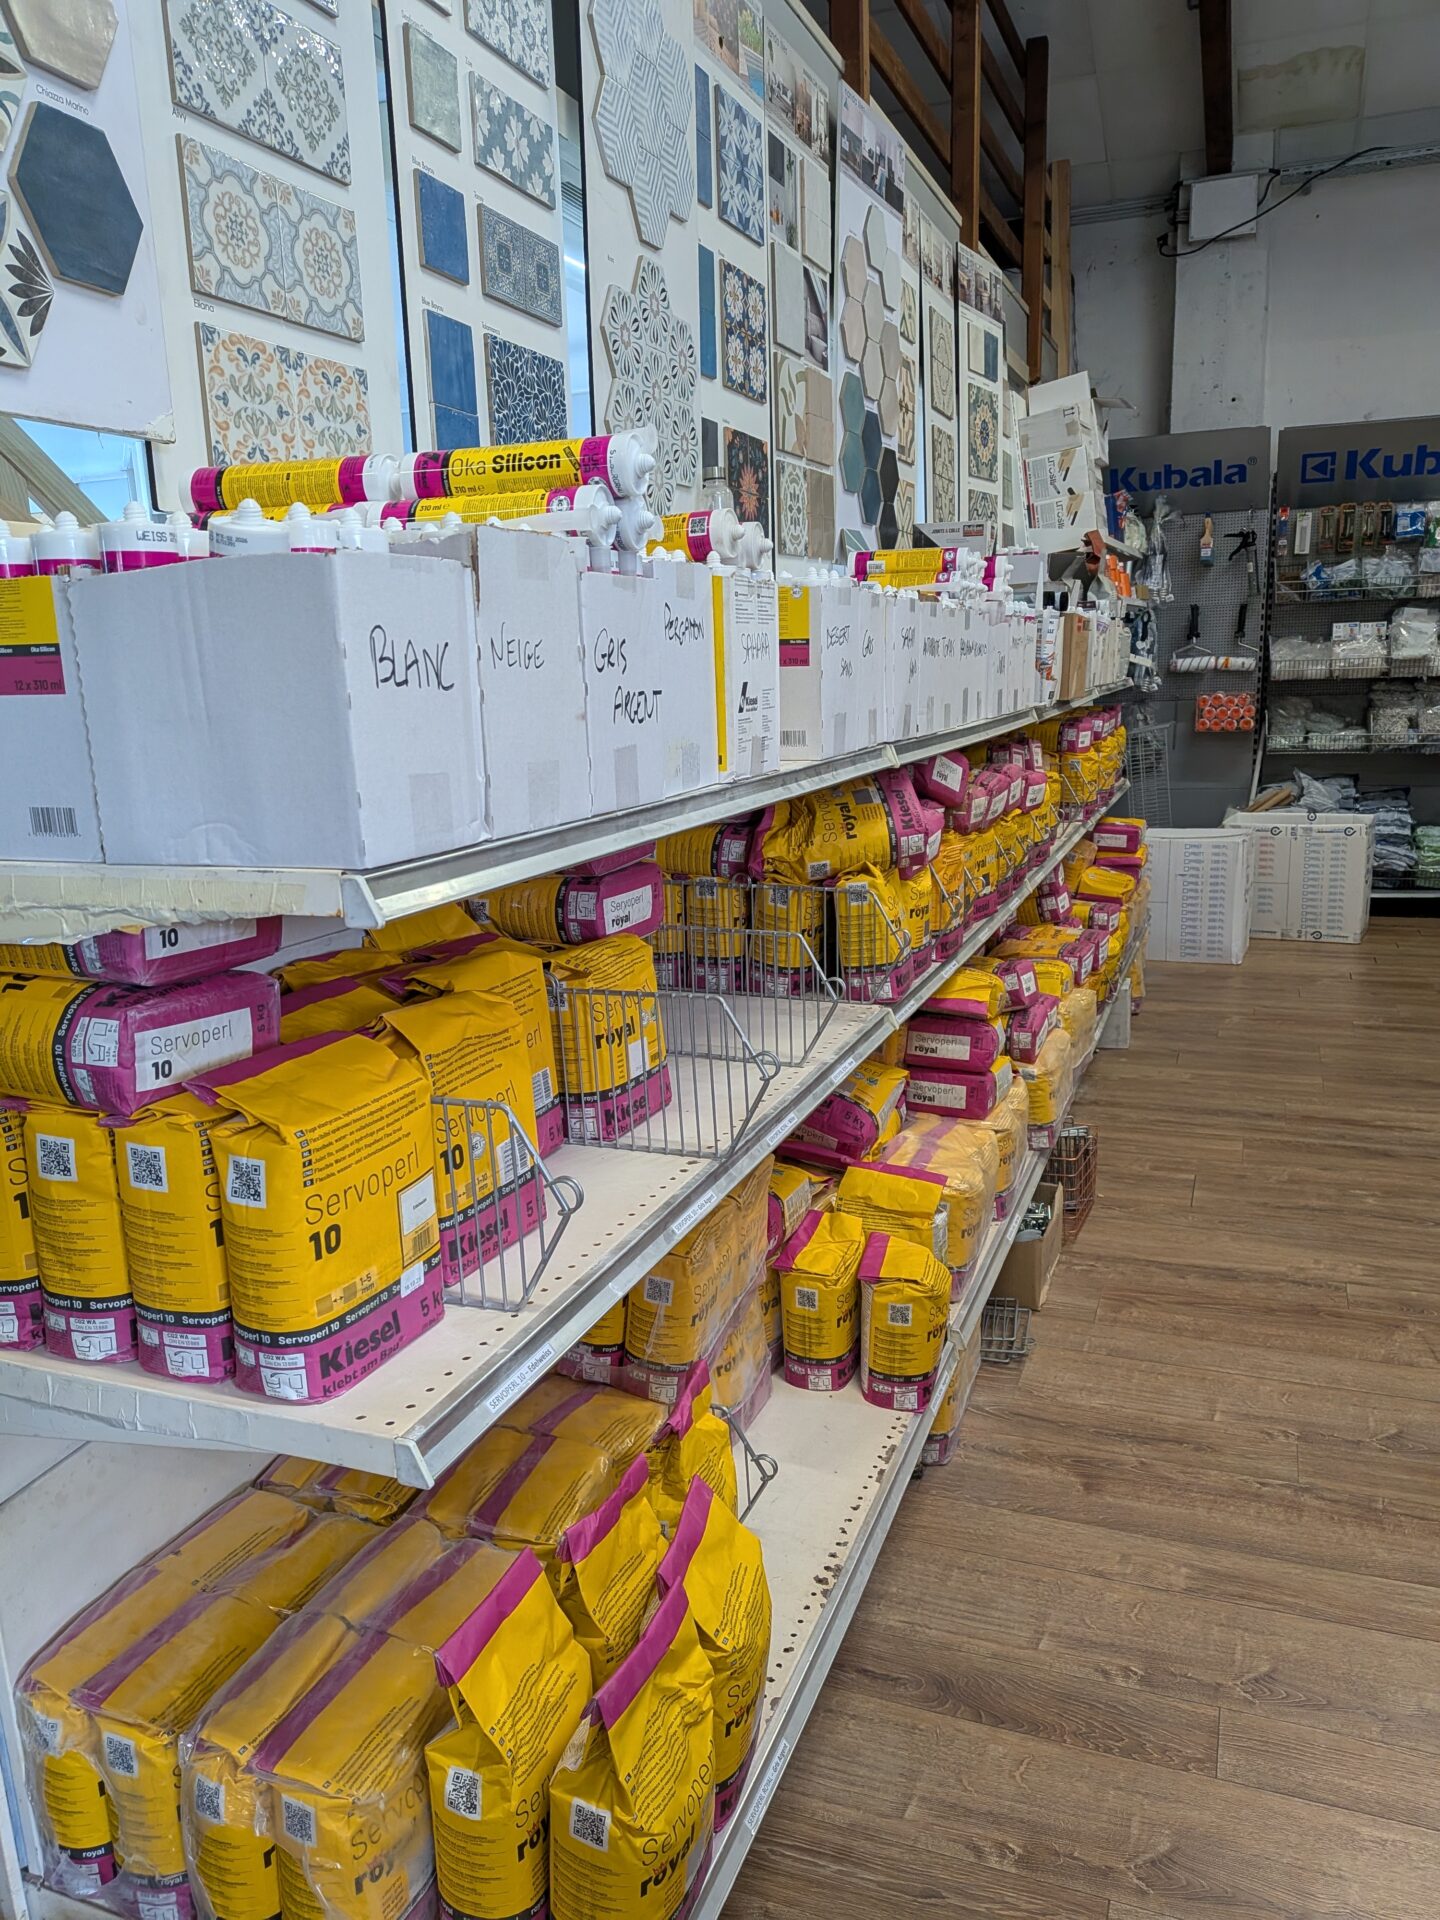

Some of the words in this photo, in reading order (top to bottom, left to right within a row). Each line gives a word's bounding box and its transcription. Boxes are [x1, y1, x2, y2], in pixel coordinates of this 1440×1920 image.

[451, 457, 487, 477] Oka
[492, 452, 562, 474] Silicon
[1109, 459, 1248, 493] Kubala
[453, 485, 470, 494] 310
[419, 503, 434, 512] 310
[136, 530, 168, 542] WEISS
[663, 602, 705, 646] PERGAMON
[369, 624, 455, 692] BLANC
[490, 621, 545, 670] NEIGE
[593, 627, 628, 675] GRIS
[15, 680, 24, 691] 12
[25, 682, 32, 691] x
[32, 680, 49, 691] 310
[50, 679, 63, 690] ml
[835, 802, 858, 840] royal
[610, 892, 645, 913] Servoperl
[611, 911, 631, 928] royal
[159, 928, 179, 948] 10
[57, 994, 87, 1038] Servoperl
[149, 1019, 233, 1056] Servoperl
[595, 1015, 636, 1050] royal
[915, 1033, 958, 1046] Servoperl
[54, 1043, 63, 1057] 10
[914, 1044, 939, 1054] royal
[56, 1056, 76, 1102] Servoperl
[151, 1059, 173, 1081] 10
[912, 1092, 936, 1103] royal
[913, 1082, 954, 1095] Servoperl
[435, 1083, 518, 1144] Servoperl
[604, 1095, 647, 1126] Kiese
[439, 1143, 465, 1176] 10
[304, 1141, 420, 1226] Servoperl
[526, 1200, 534, 1217] 5
[308, 1223, 341, 1261] 10
[448, 1208, 510, 1262] Kiesel
[361, 1282, 375, 1295] mm
[72, 1300, 83, 1310] 10
[164, 1313, 175, 1324] 10
[181, 1310, 231, 1326] Servoperl
[260, 1334, 271, 1345] 10
[278, 1325, 330, 1346] Servoperl
[330, 1320, 341, 1332] 10
[345, 1297, 379, 1324] Servoperl
[379, 1291, 389, 1302] 10
[420, 1296, 430, 1317] 5
[319, 1310, 402, 1380] Kiesel
[322, 1369, 358, 1397] klebt
[360, 1358, 378, 1374] am
[489, 1380, 520, 1410] SERVOPERL
[517, 1372, 526, 1382] 10
[527, 1347, 553, 1373] Edelweiss
[746, 1794, 766, 1825] SERVOPERL
[82, 1847, 105, 1858] royal
[640, 1823, 696, 1898] royal
